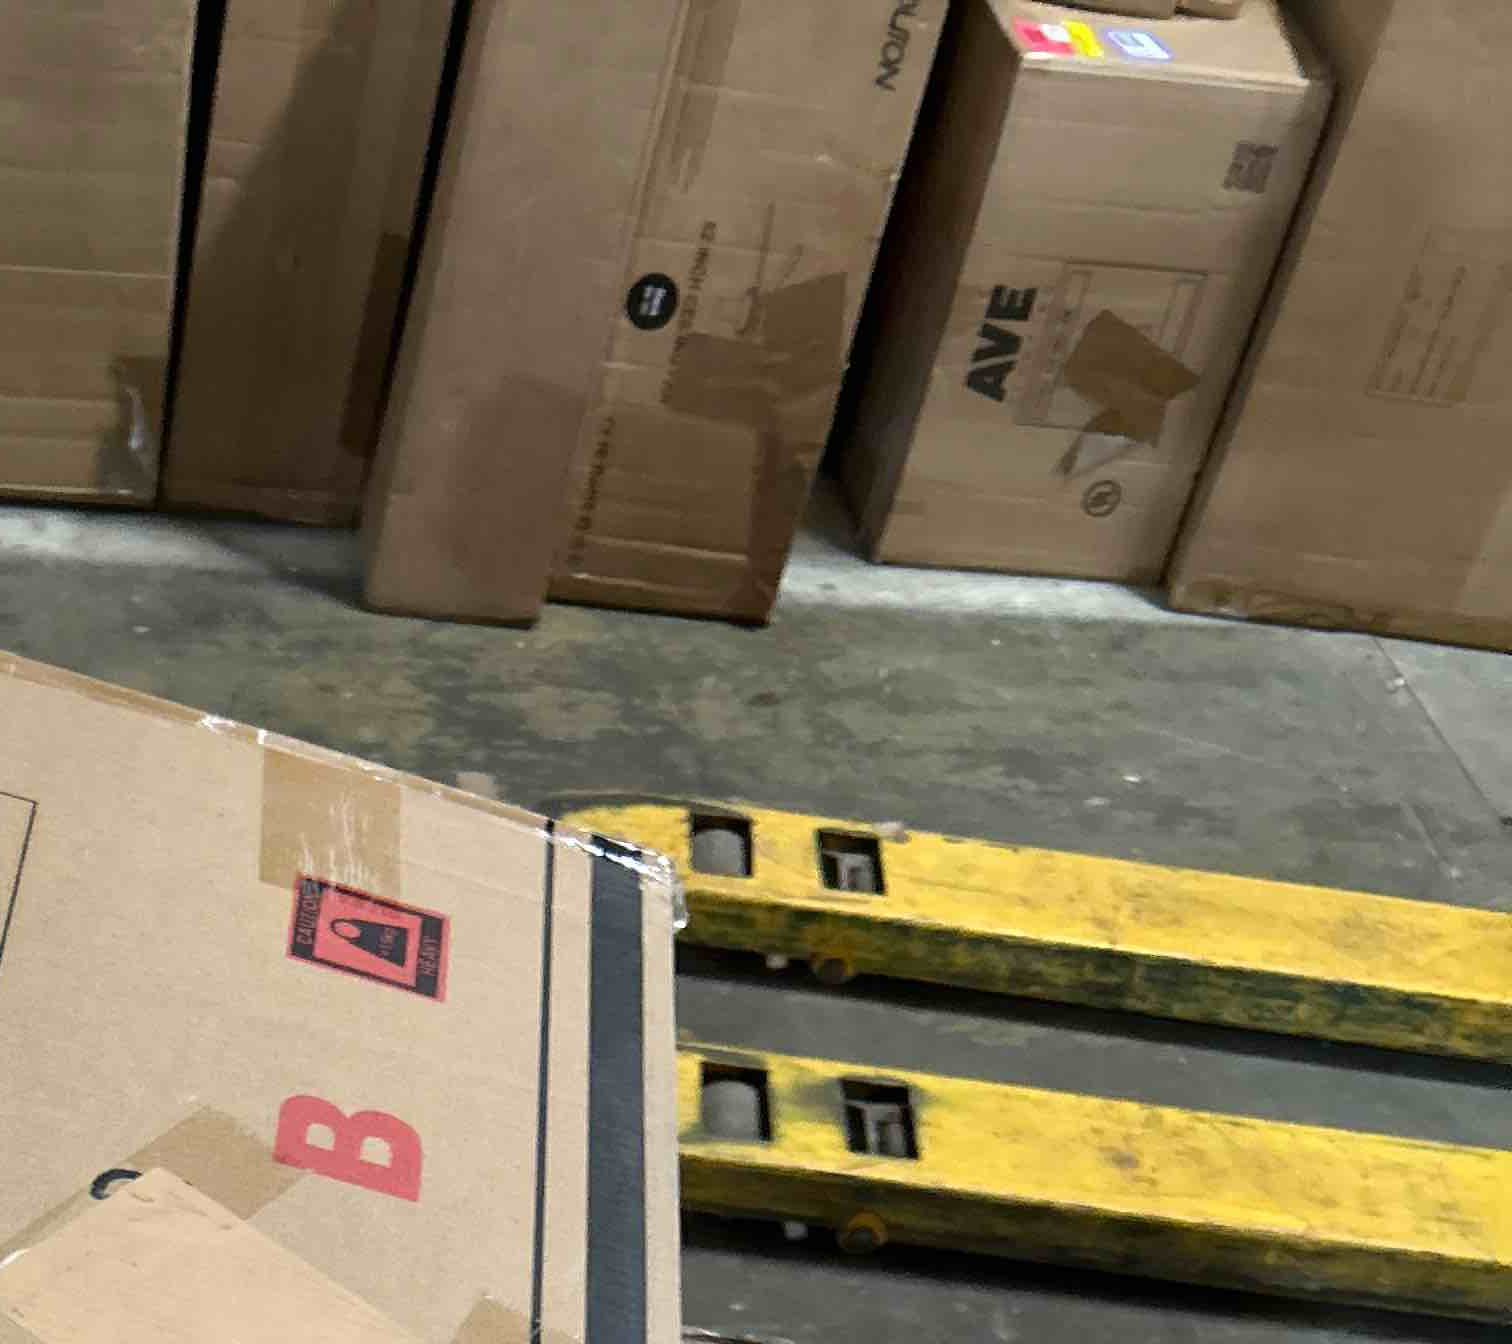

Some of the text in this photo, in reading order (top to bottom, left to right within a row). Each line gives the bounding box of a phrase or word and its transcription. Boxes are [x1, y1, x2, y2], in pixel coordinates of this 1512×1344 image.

[963, 284, 1038, 403] AVE
[419, 935, 437, 977] HEAVY
[272, 1093, 422, 1202] B
